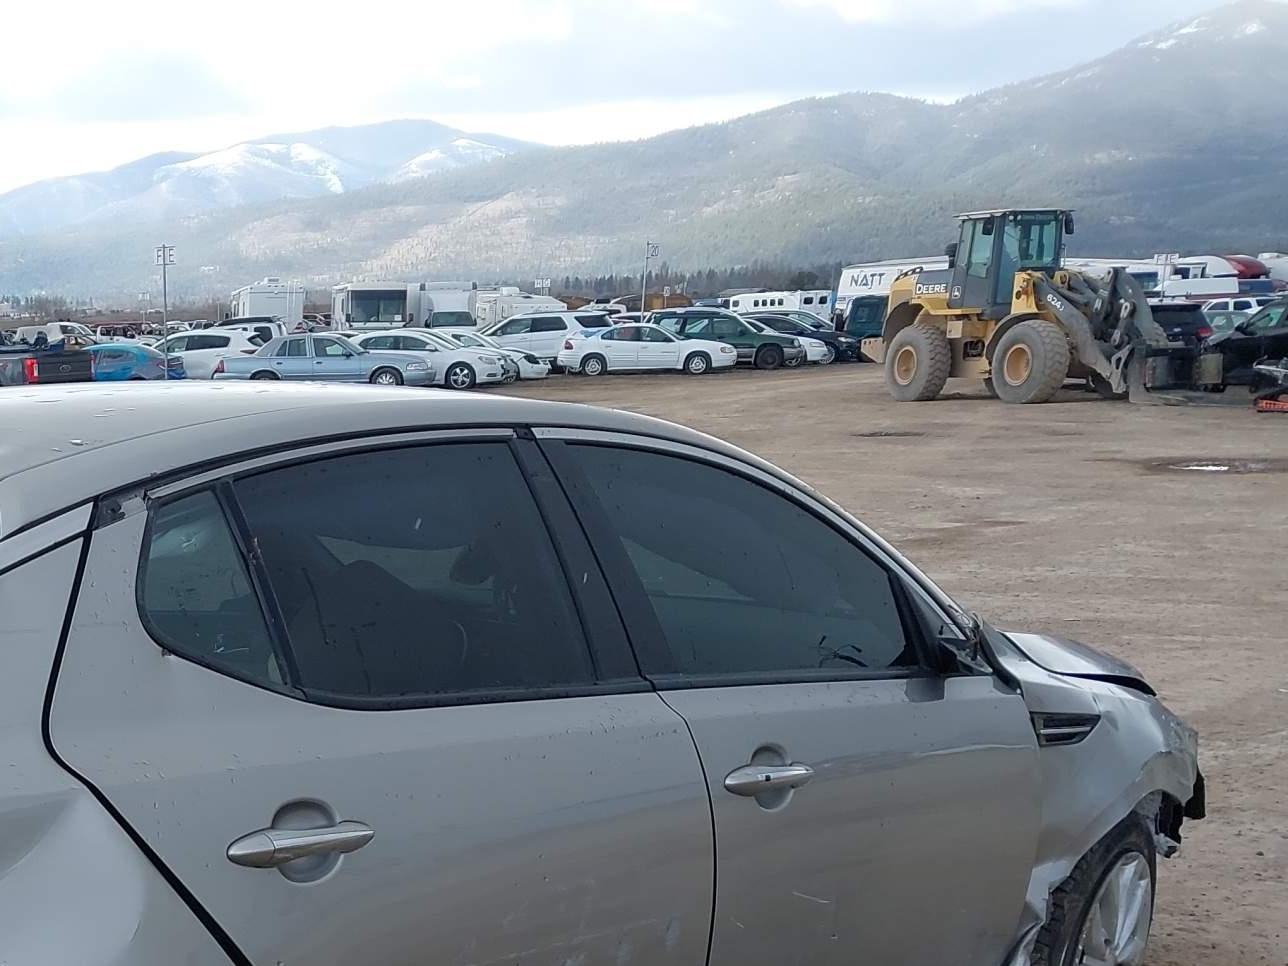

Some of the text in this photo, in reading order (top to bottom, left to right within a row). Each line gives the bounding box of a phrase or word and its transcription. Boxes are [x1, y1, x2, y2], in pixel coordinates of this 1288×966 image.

[156, 248, 175, 264] F E
[650, 245, 660, 256] 20
[849, 272, 886, 289] NATT
[915, 283, 947, 295] DEERE
